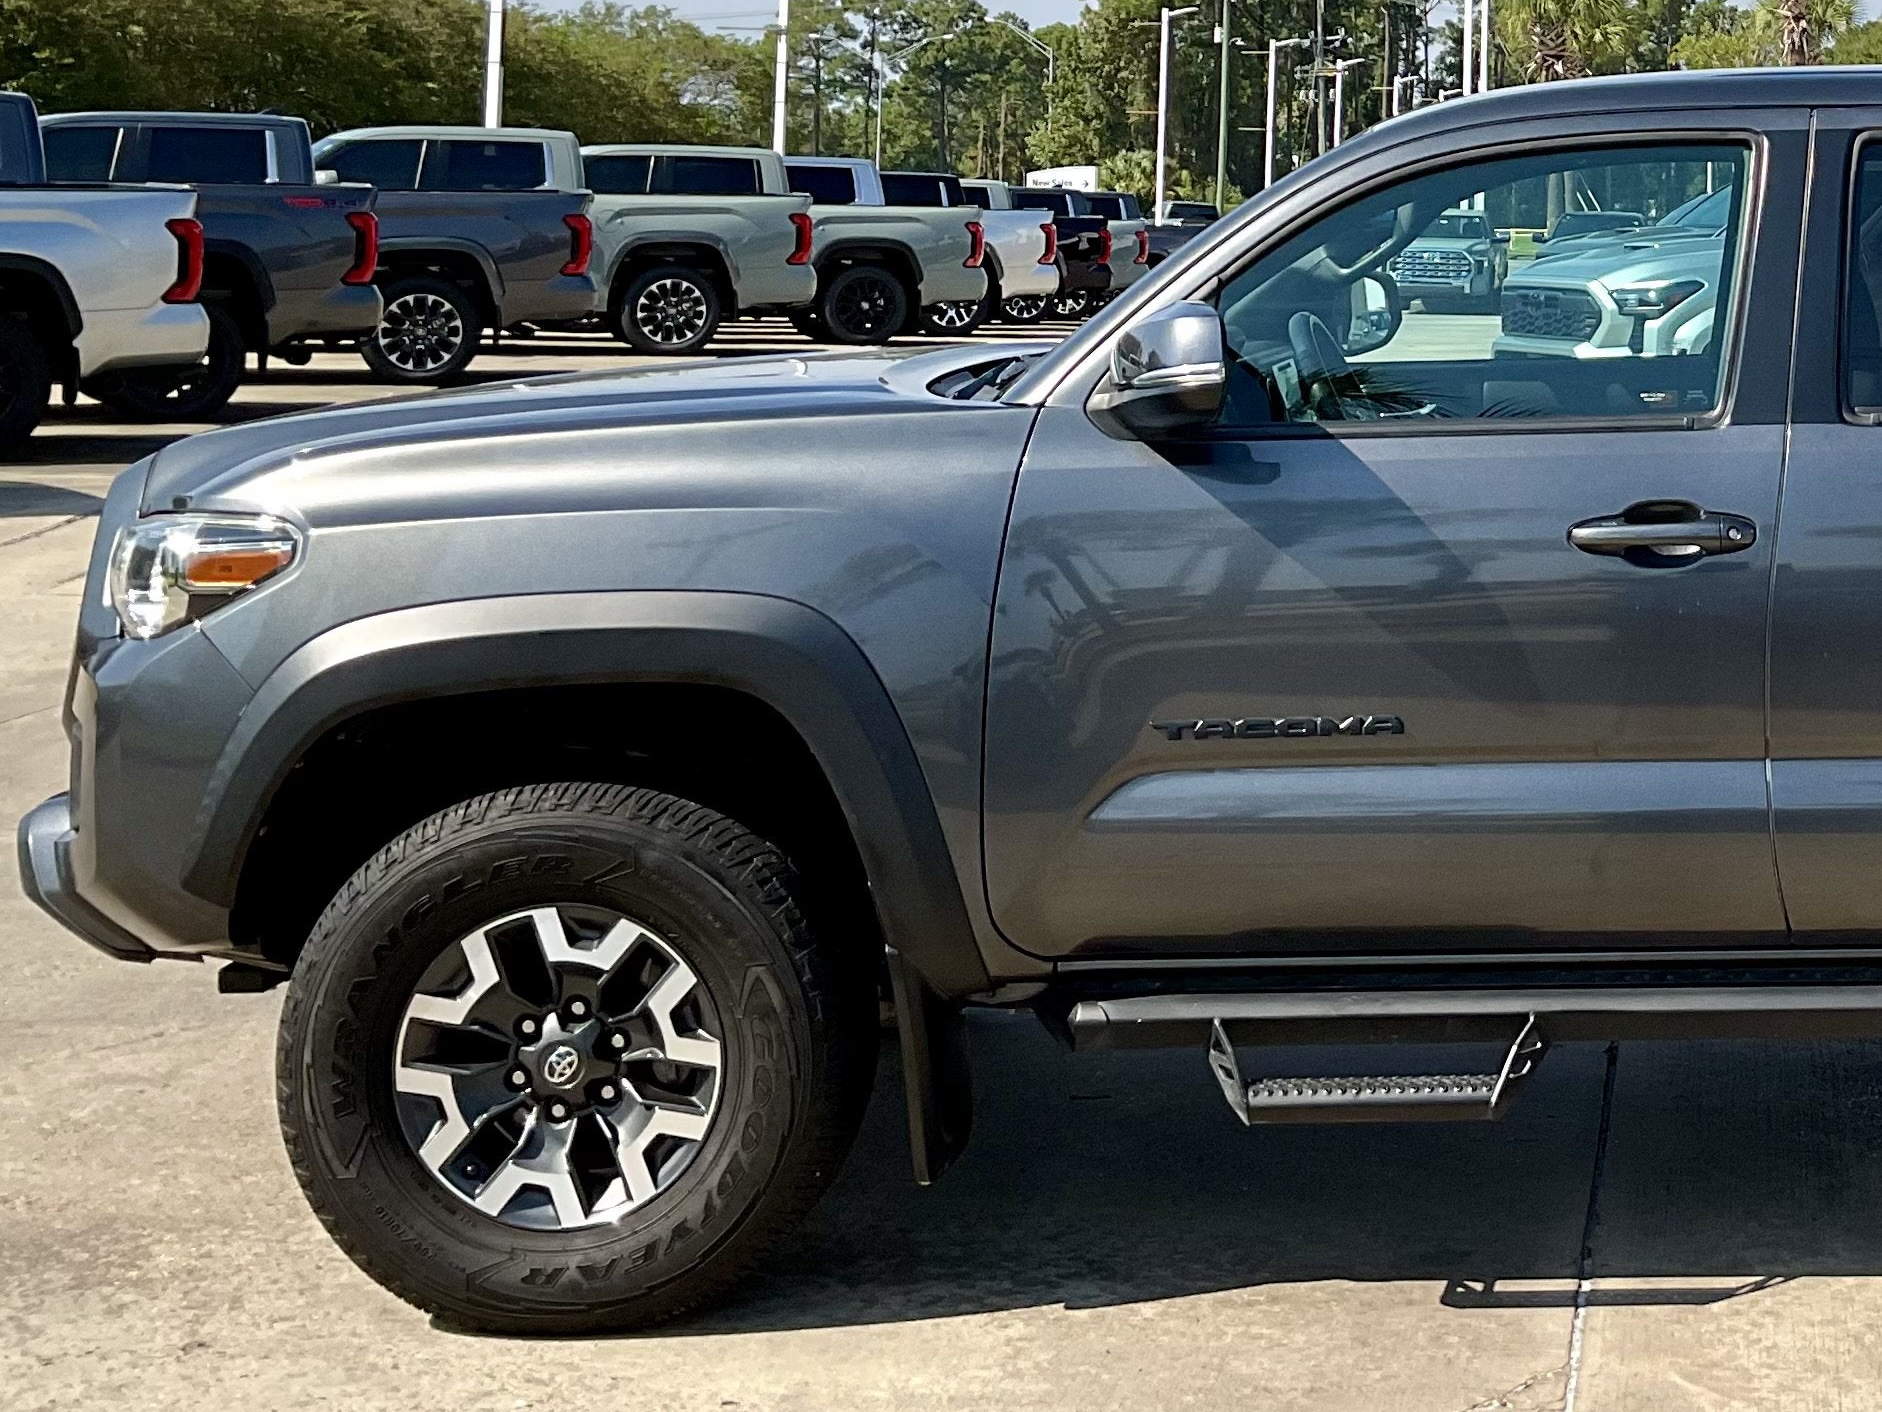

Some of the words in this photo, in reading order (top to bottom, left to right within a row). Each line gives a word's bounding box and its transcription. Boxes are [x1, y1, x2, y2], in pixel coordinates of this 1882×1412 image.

[1148, 714, 1405, 740] TACOMA
[333, 852, 575, 1120] WRANGLER
[519, 1014, 776, 1290] GOODYEAR
